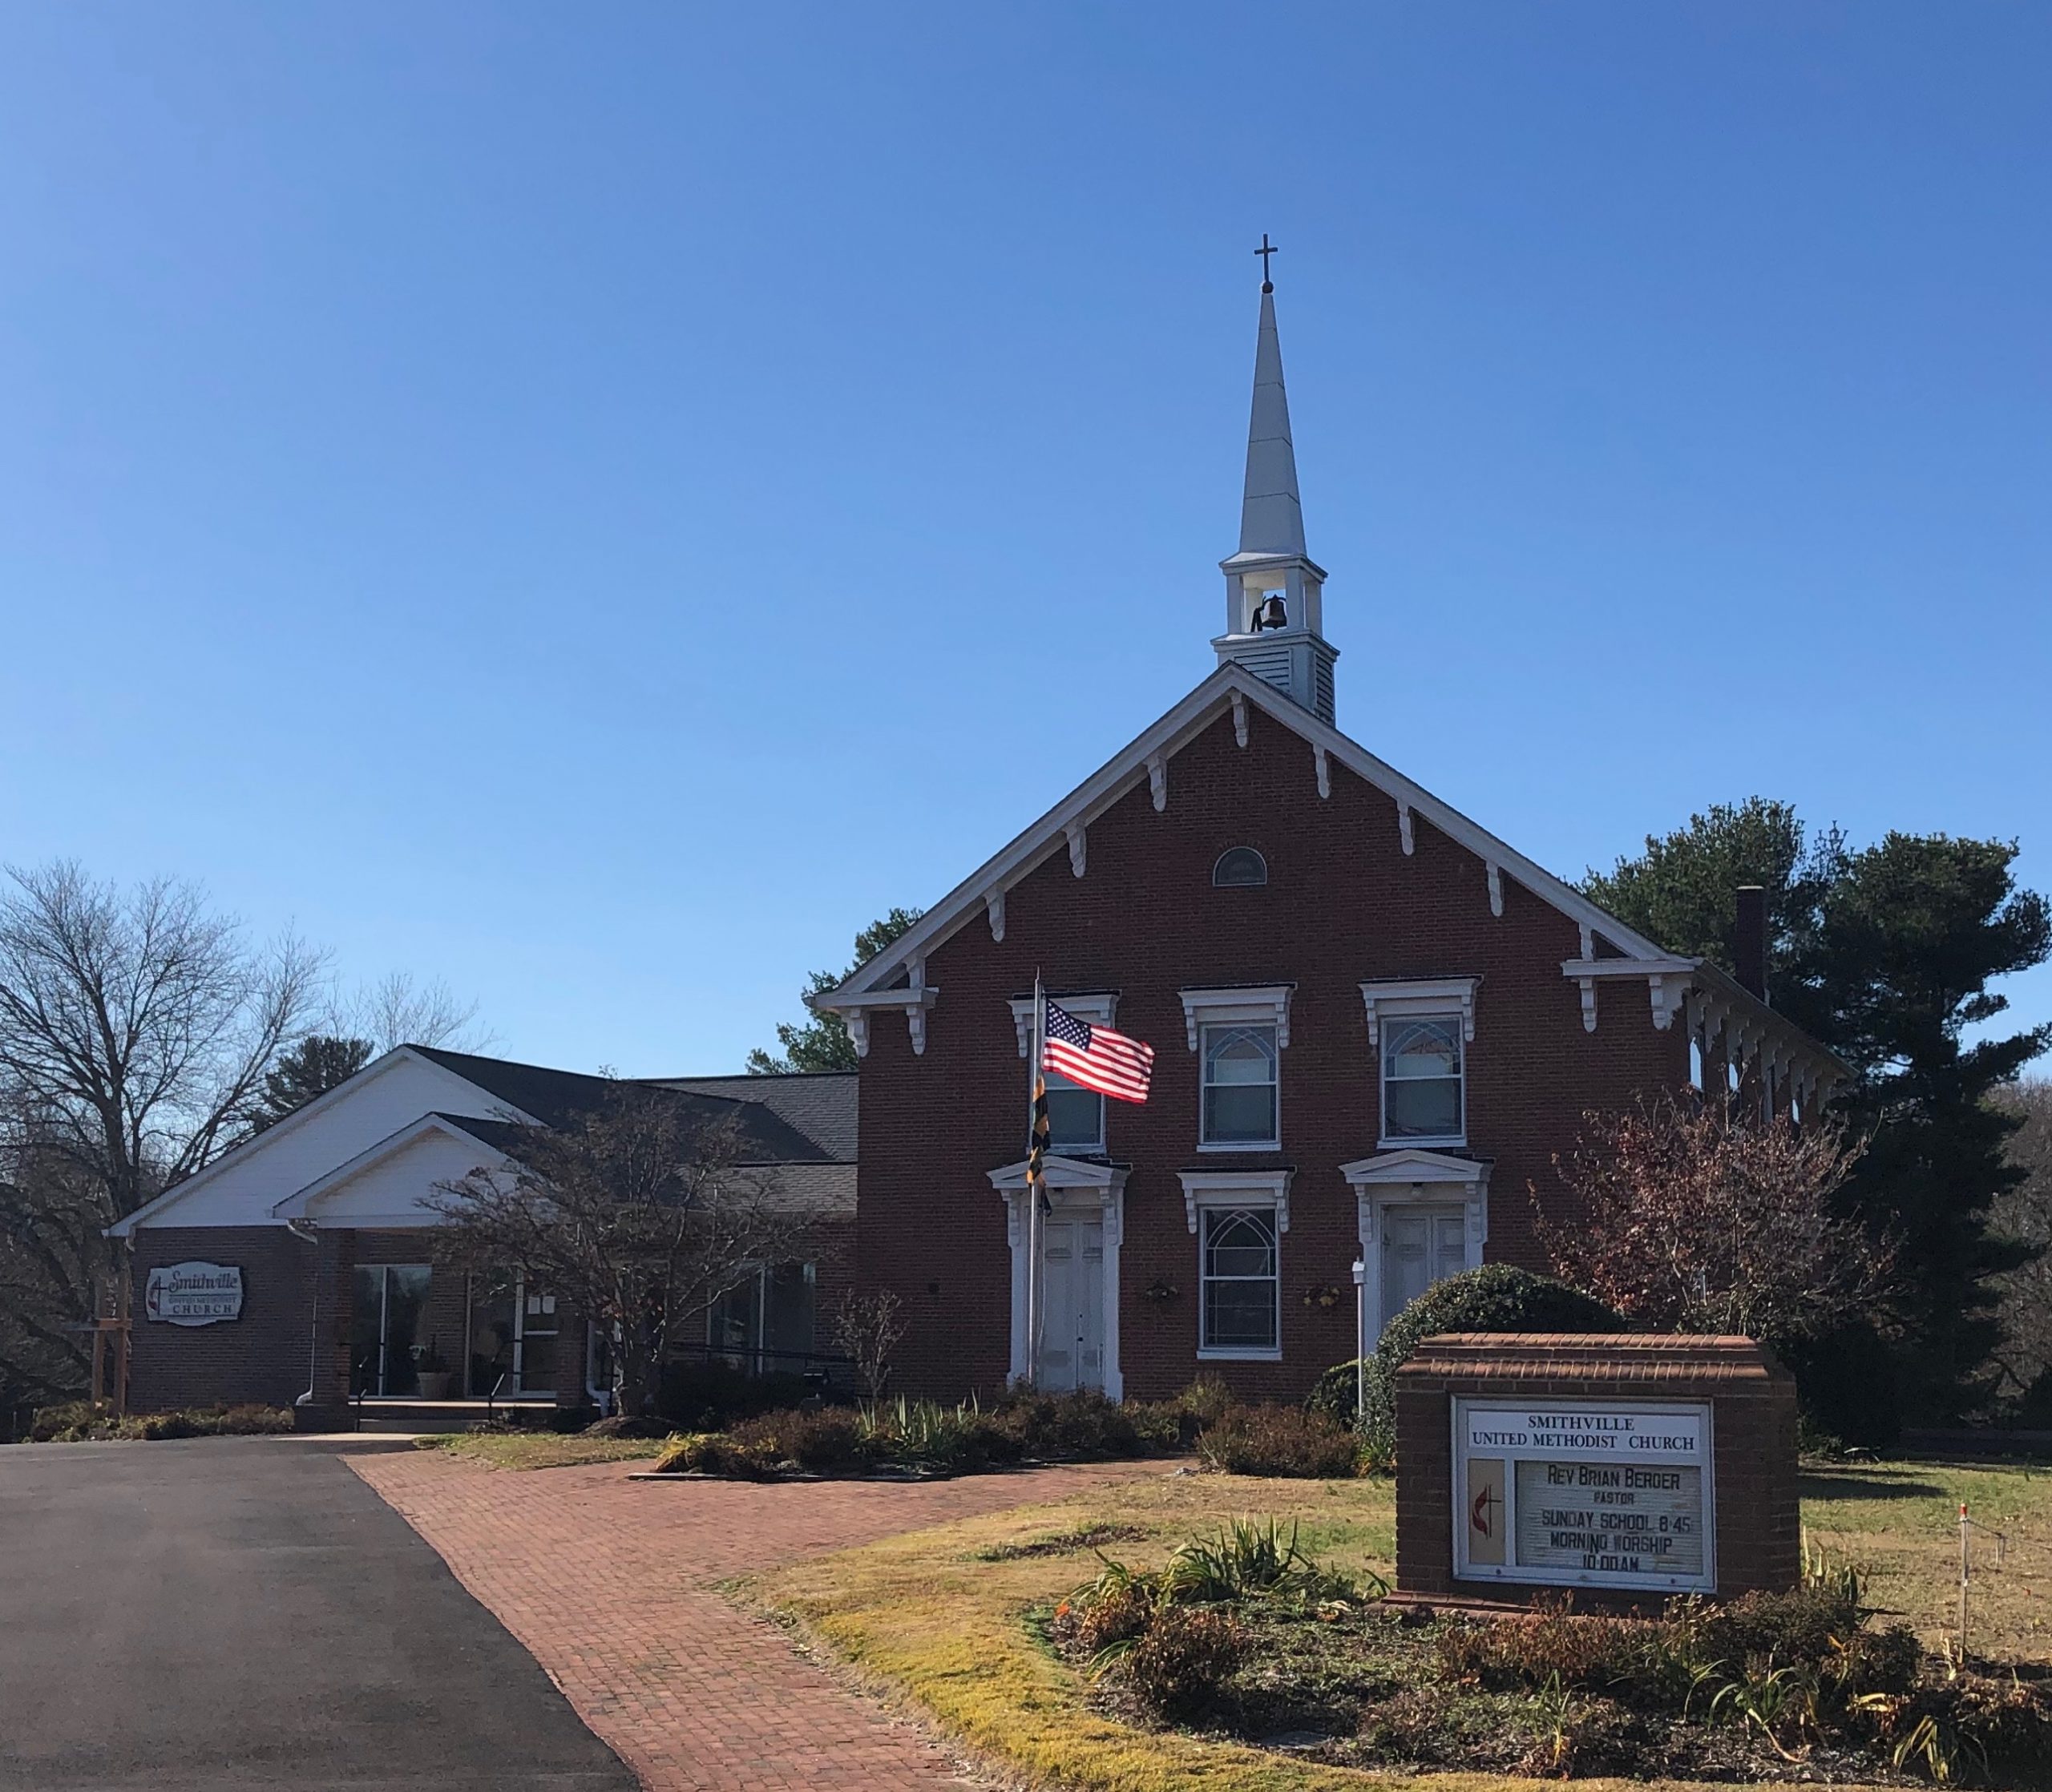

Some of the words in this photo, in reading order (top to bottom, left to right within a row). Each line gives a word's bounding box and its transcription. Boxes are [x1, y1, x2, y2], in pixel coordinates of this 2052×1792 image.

[168, 1270, 238, 1293] Smithville
[173, 1305, 232, 1314] CHURCH
[1528, 1415, 1635, 1431] SMITHVILLE
[1472, 1432, 1528, 1446] UNITED
[1533, 1433, 1618, 1449] METHODIST
[1628, 1435, 1695, 1451] CHURCH
[1594, 1491, 1634, 1504] PASTOR
[1541, 1510, 1594, 1528] SUNDAY
[1600, 1513, 1654, 1531] SCHOOL
[1550, 1532, 1607, 1554] MORNING
[1614, 1536, 1673, 1554] WORSHIP
